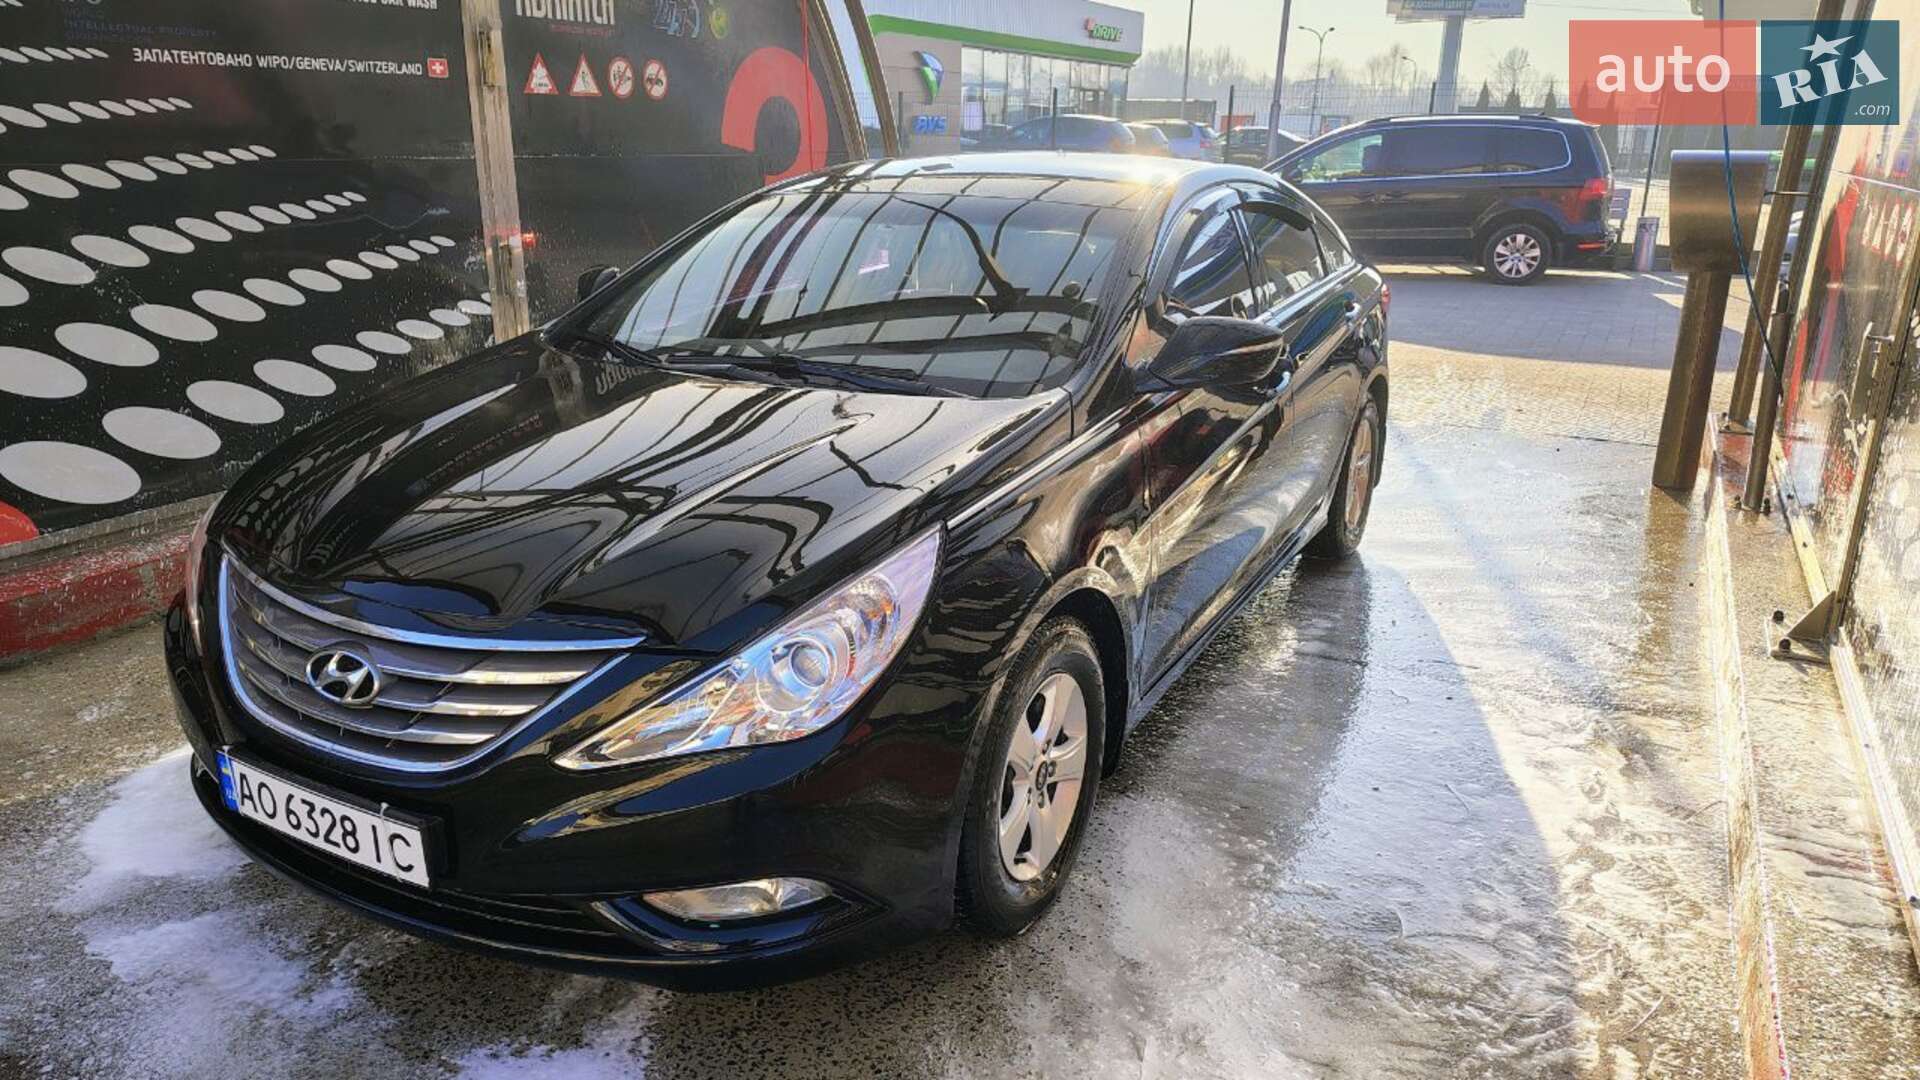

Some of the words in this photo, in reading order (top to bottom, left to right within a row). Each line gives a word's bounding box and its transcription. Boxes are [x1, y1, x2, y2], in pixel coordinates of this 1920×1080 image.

[132, 48, 252, 68] ЗАПАТЕНТОВАНО
[256, 54, 423, 76] WIPO/GENEVA/SWITZERLAND
[239, 772, 277, 820] AO
[285, 793, 360, 855] 6328
[371, 824, 414, 873] IC
